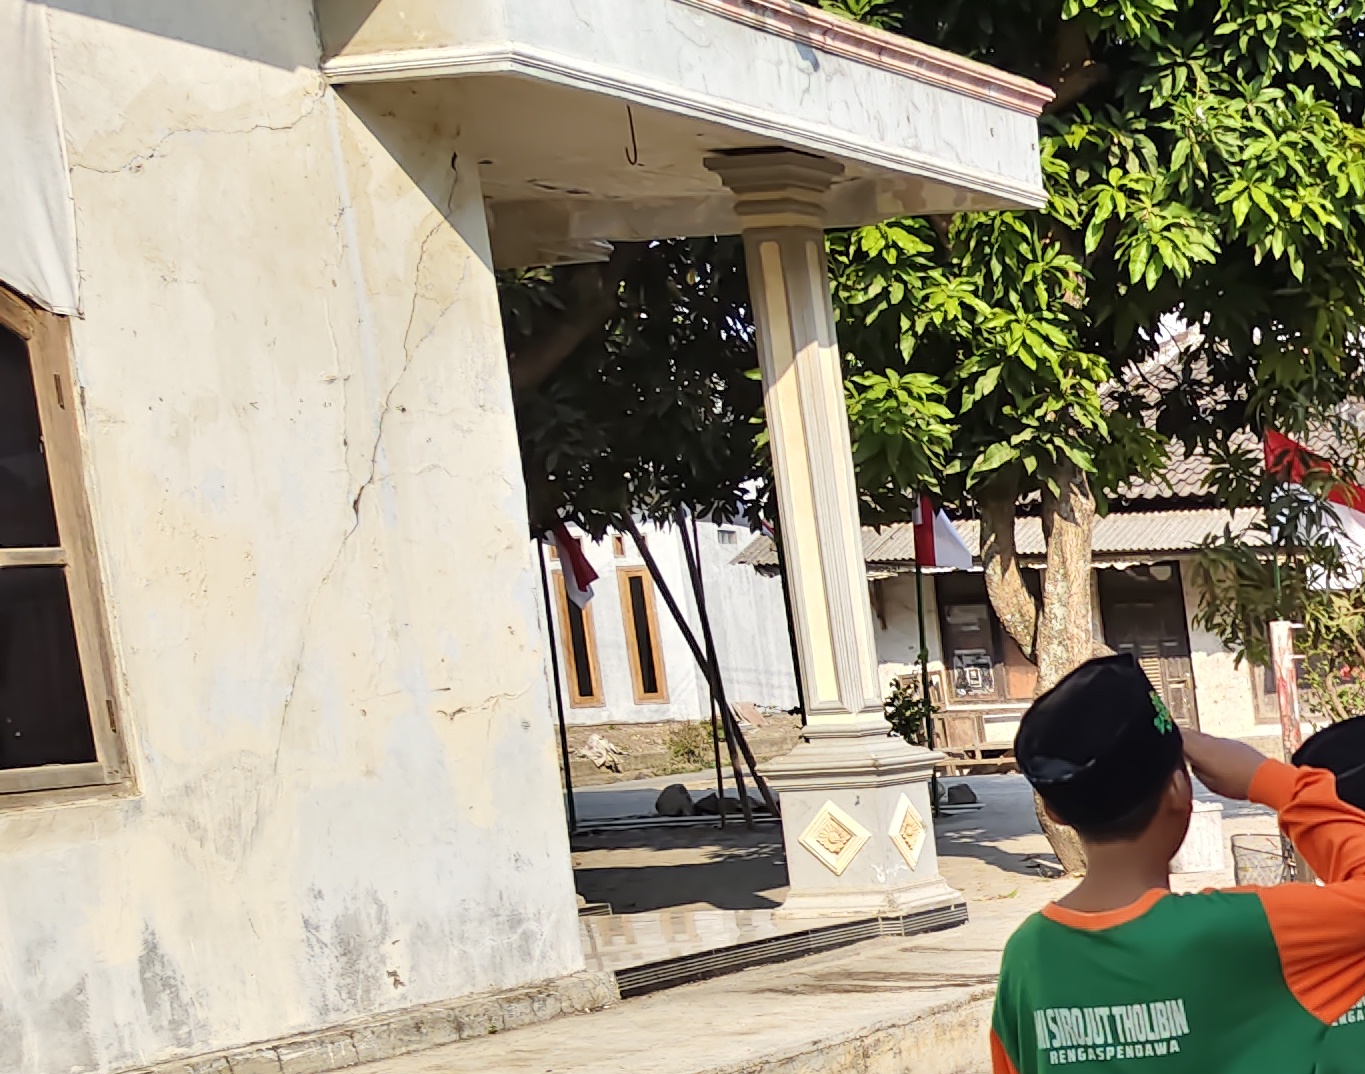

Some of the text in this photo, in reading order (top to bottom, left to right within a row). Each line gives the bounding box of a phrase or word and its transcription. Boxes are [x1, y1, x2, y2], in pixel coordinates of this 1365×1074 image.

[1046, 1006, 1114, 1048] SIROJUT
[1111, 998, 1191, 1043] THOLIBIN
[1050, 1040, 1181, 1065] RENGASPENDAWA
